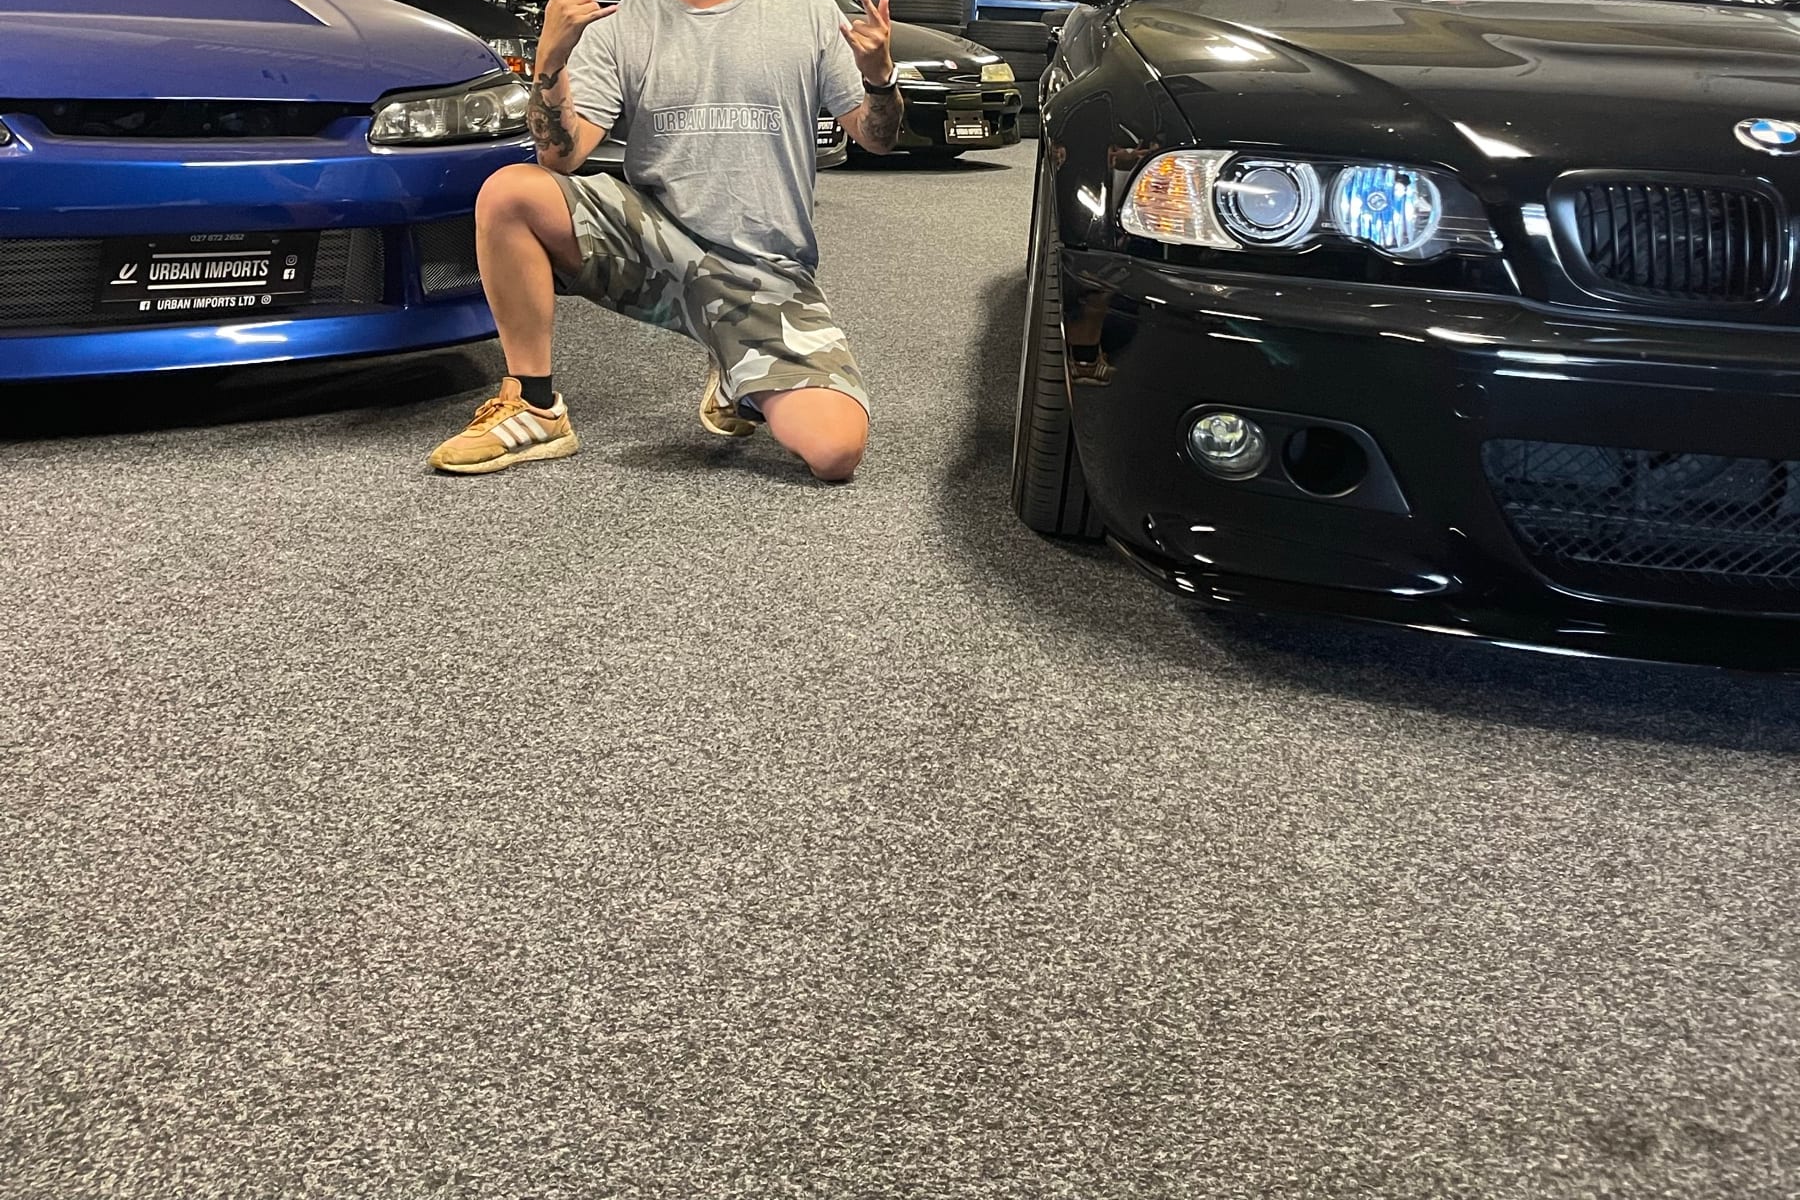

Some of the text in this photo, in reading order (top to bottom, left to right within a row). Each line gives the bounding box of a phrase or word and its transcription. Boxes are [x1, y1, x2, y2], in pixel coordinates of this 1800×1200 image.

[654, 107, 781, 132] URBAN IMPORTS
[149, 260, 269, 280] URBAN IMPORTS
[157, 295, 256, 310] URBAN IMPORTS LTD
